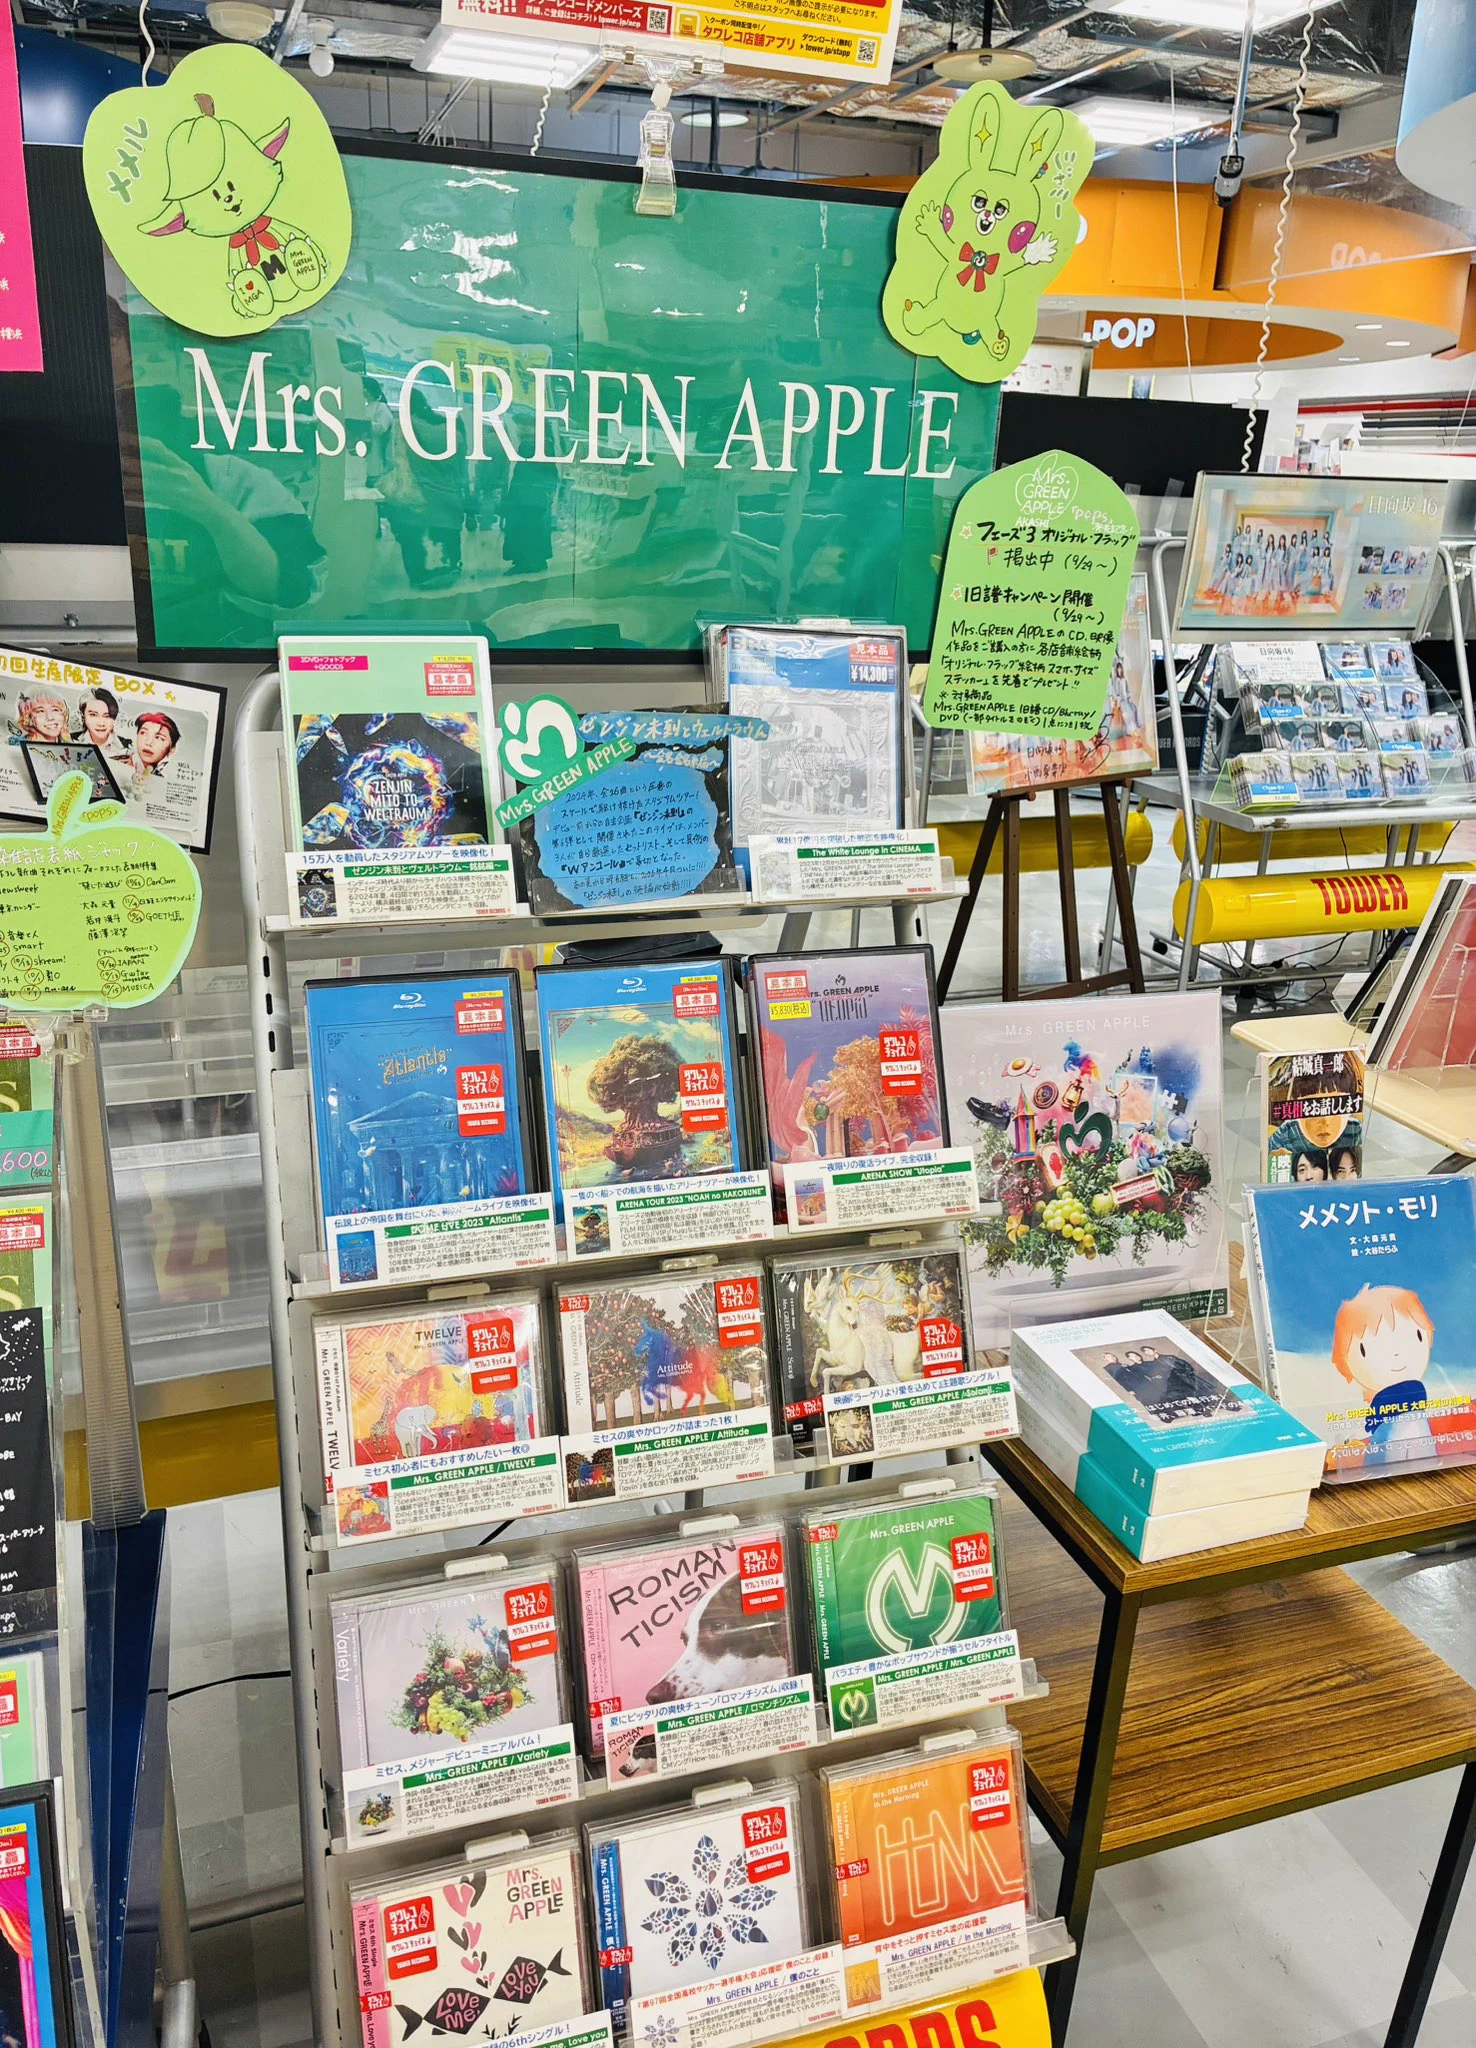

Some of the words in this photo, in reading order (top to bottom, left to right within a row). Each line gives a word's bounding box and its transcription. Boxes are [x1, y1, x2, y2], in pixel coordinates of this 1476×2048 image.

[703, 26, 796, 50] タワレコ店舗アプリ
[260, 253, 287, 281] M
[244, 289, 264, 305] MGA
[184, 347, 368, 458] Mrs.
[399, 360, 695, 469] GREEN
[713, 377, 960, 480] APPLE
[1015, 516, 1049, 528] AKASHI
[1004, 548, 1054, 571] 掲出中
[856, 643, 889, 656] 見本品
[850, 664, 888, 683] ¥14,300
[113, 675, 155, 695] BOX
[374, 780, 412, 794] ZENJIN
[370, 793, 400, 808] MITO
[403, 793, 418, 807] TO
[363, 807, 426, 821] WELTRAUM
[812, 848, 826, 857] The
[827, 847, 849, 856] White
[851, 847, 880, 857] Lounge
[881, 846, 888, 854] in
[889, 845, 921, 854] CINEMA
[1312, 874, 1409, 916] TOWER
[145, 911, 181, 921] GOETHE
[7, 930, 39, 941] 音楽と人
[13, 941, 44, 952] smart
[122, 983, 154, 993] MUSICA
[770, 977, 805, 989] 見本品
[679, 994, 713, 1006] 見本品
[463, 1010, 497, 1022] 見本品
[1291, 1053, 1344, 1078] 結城真一郎
[461, 1071, 489, 1084] タワレコ
[462, 1082, 488, 1095] チョイス
[1273, 1096, 1363, 1119] #真相をお話しします
[860, 1172, 888, 1181] ARENA
[888, 1169, 912, 1178] SHOW
[619, 1200, 645, 1209] ARENA
[645, 1198, 665, 1207] TOUR
[666, 1196, 684, 1205] 2023
[1299, 1194, 1438, 1229] メメント・モリ
[462, 1219, 484, 1229] 2023
[719, 1284, 743, 1296] タワレコ
[720, 1295, 744, 1308] チョイス
[415, 1326, 462, 1341] TWELVE
[472, 1328, 499, 1342] タワレコ
[473, 1339, 500, 1353] チョイス
[656, 1361, 694, 1374] Attitude
[892, 1401, 907, 1410] Mrs.
[909, 1396, 936, 1407] GREEN
[937, 1391, 960, 1403] APPLE
[634, 1441, 651, 1452] Mrs.
[653, 1436, 682, 1449] GREEN
[684, 1432, 709, 1444] APPLE
[717, 1427, 750, 1440] Attitude
[413, 1474, 432, 1485] Mrs.
[434, 1469, 465, 1482] GREEN
[468, 1464, 495, 1476] APPLE
[503, 1458, 536, 1470] TWELVE
[870, 1529, 890, 1540] Mrs.
[892, 1522, 925, 1535] GREEN
[926, 1515, 955, 1529] APPLE
[743, 1551, 768, 1563] タワレコ
[744, 1561, 769, 1574] チョイス
[608, 1539, 737, 1615] ROMAN
[509, 1593, 535, 1607] タワレコ
[620, 1560, 728, 1648] TICISM
[511, 1605, 537, 1619] チョイス
[336, 1629, 352, 1682] Variety
[877, 1674, 893, 1683] Mrs.
[895, 1668, 920, 1680] GREEN
[921, 1663, 944, 1674] APPLE
[950, 1658, 966, 1667] Mrs.
[967, 1653, 991, 1664] GREEN
[993, 1647, 1014, 1659] APPLE
[667, 1719, 685, 1729] Mrs.
[687, 1713, 716, 1726] GREEN
[718, 1707, 743, 1719] APPLE
[750, 1695, 800, 1712] ロマンチシズム
[424, 1772, 445, 1783] Mrs.
[447, 1764, 478, 1778] GREEN
[481, 1757, 508, 1770] APPLE
[517, 1749, 550, 1763] Variety
[972, 1768, 995, 1780] タワレコ
[974, 1778, 996, 1791] チョイス
[873, 1800, 880, 1808] In
[882, 1797, 895, 1806] the
[896, 1791, 920, 1805] Morning
[747, 1815, 772, 1829] タワレコ
[748, 1827, 773, 1841] チョイス
[507, 1865, 543, 1887] Mrs.
[507, 1877, 563, 1901] GREEN
[389, 1905, 418, 1920] タワレコ
[509, 1893, 564, 1923] APPLE
[390, 1919, 419, 1936] チョイス
[875, 1916, 988, 1954] 背中をそっと押すミセス流の応援歌
[908, 1946, 932, 1957] GREEN
[934, 1939, 955, 1950] APPLE
[985, 1922, 1012, 1936] Morning
[568, 2035, 589, 2047] Love
[590, 2030, 607, 2041] you
